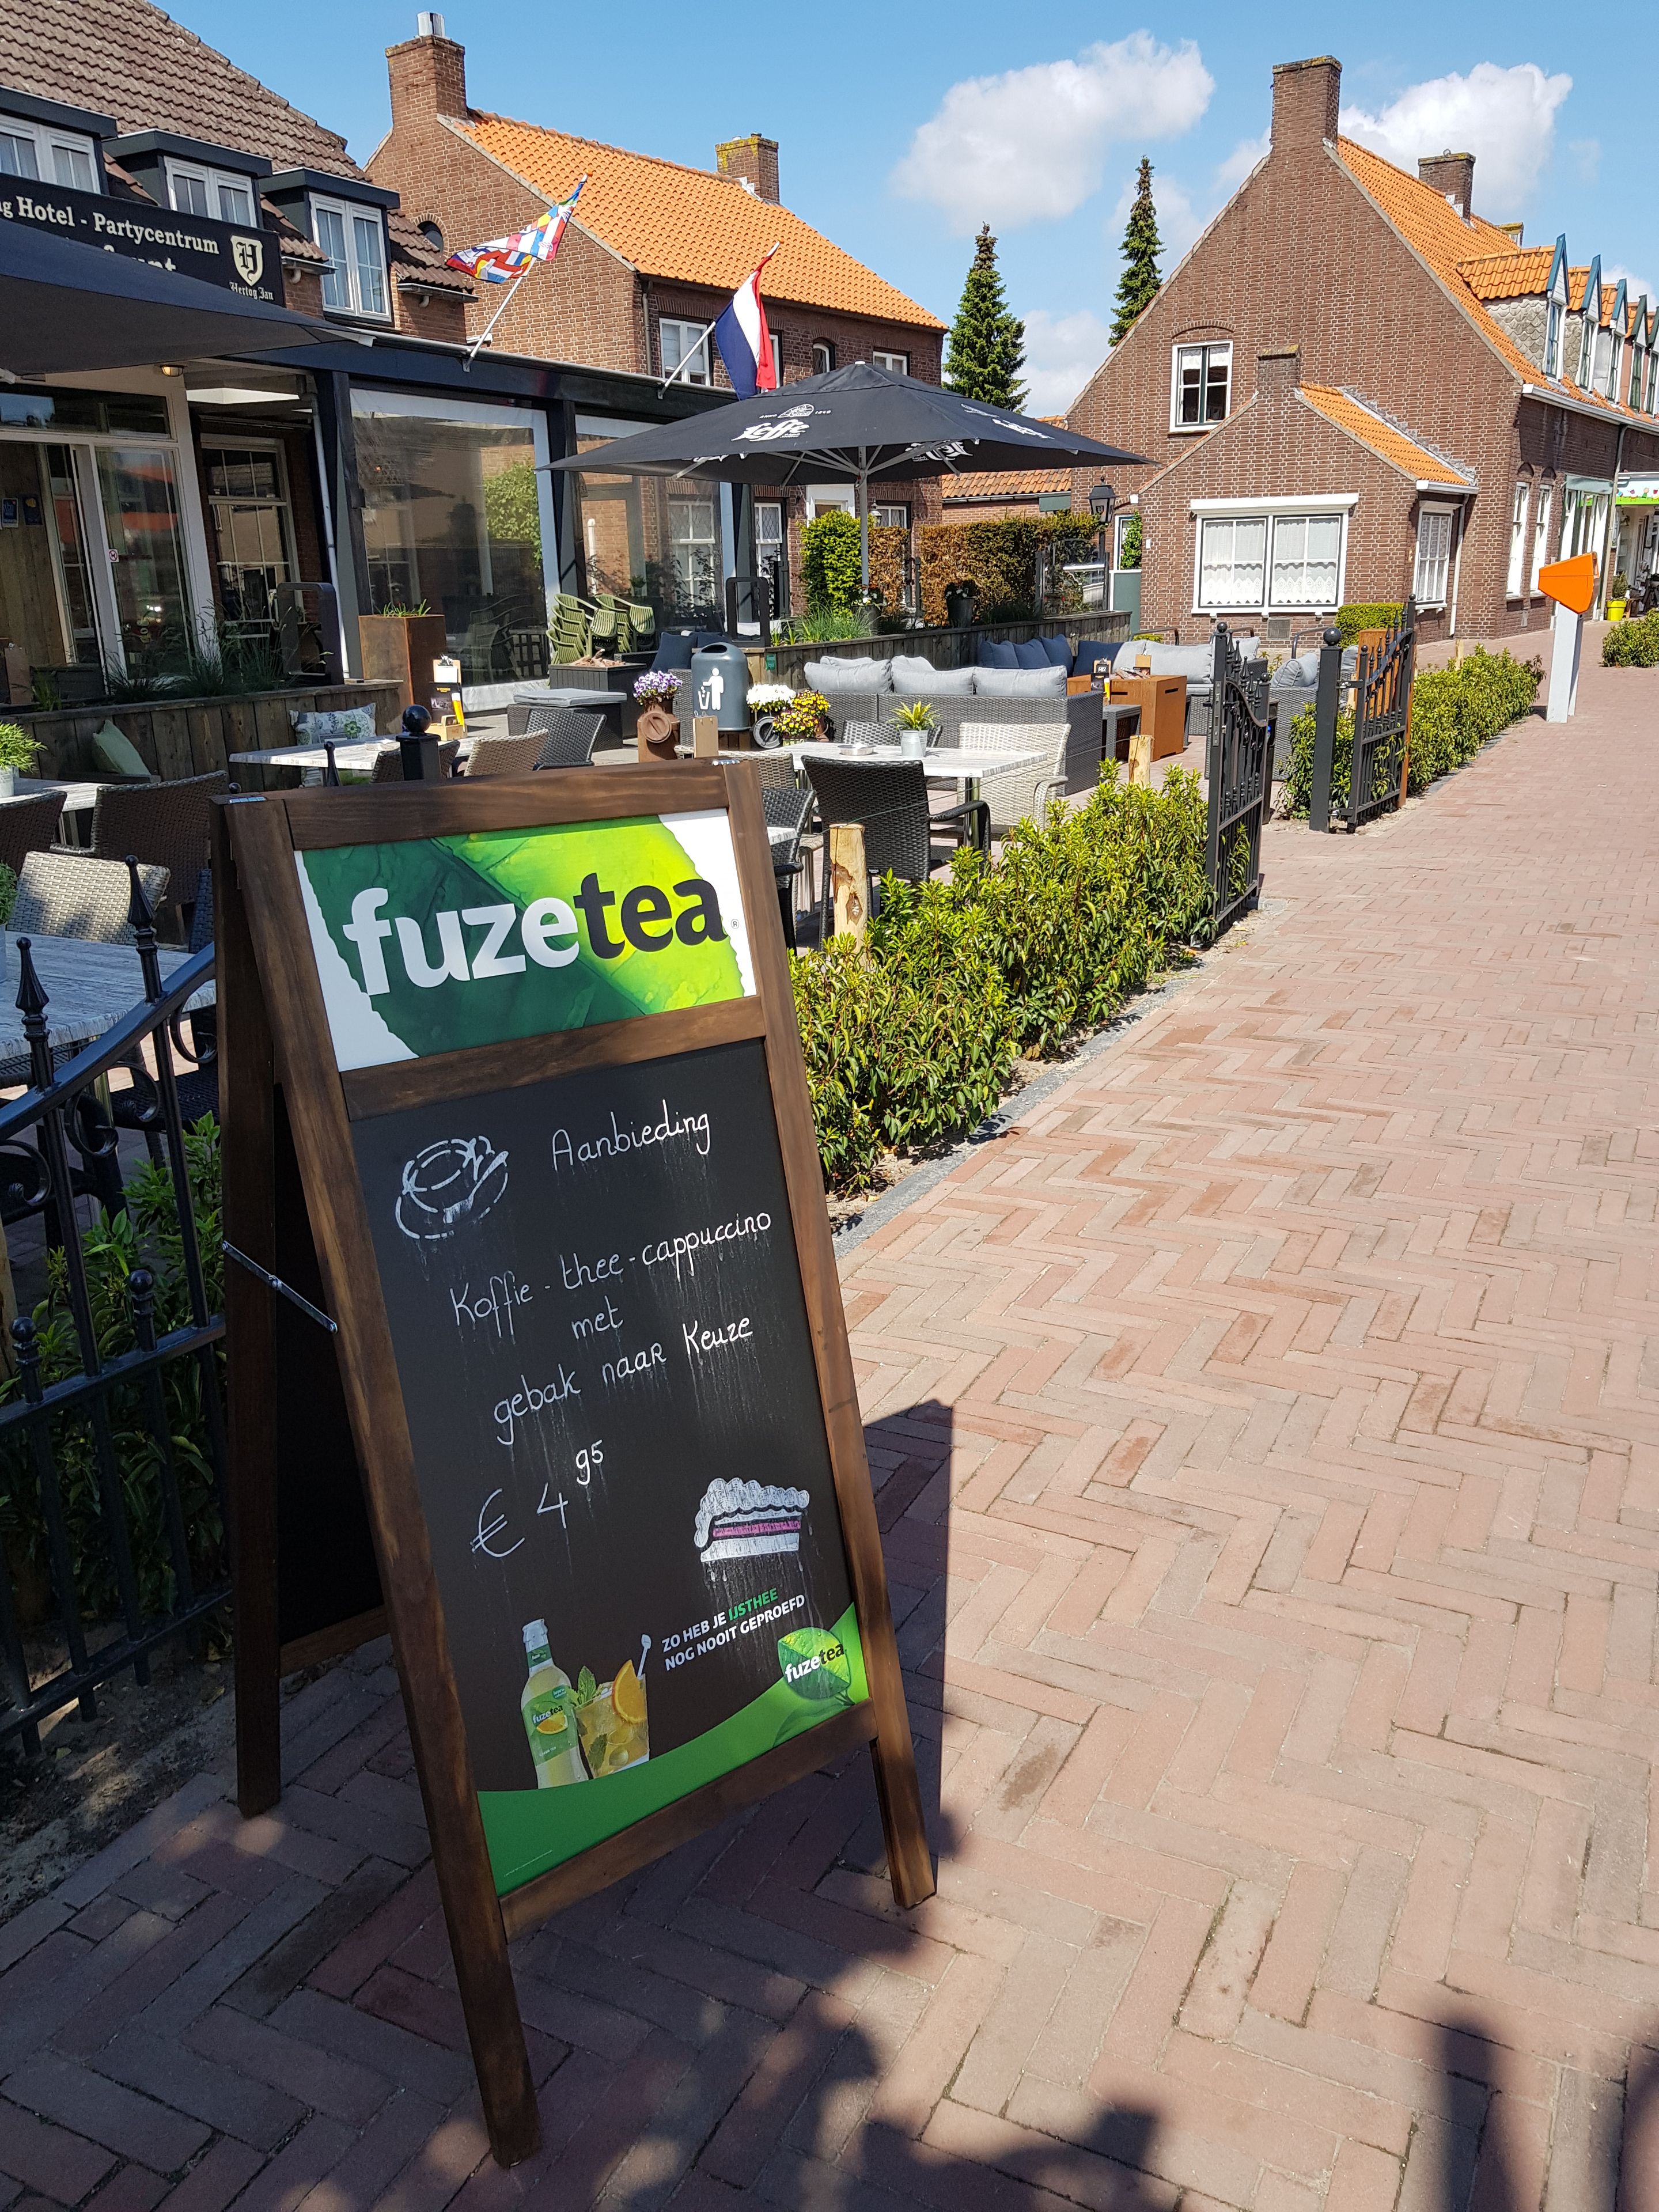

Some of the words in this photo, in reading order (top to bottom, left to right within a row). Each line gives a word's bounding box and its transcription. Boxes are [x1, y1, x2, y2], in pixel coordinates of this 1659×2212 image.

[16, 196, 75, 226] Hotel
[92, 211, 219, 254] Partycentrum
[229, 282, 257, 300] Hertog
[258, 287, 274, 301] Jan
[730, 419, 810, 442] Leffe
[343, 872, 729, 997] fuzetea
[552, 1099, 710, 1171] Aanbieding
[449, 1270, 533, 1338] Koffie
[560, 1253, 624, 1290] thee
[642, 1211, 771, 1282] cappuccino
[571, 1296, 623, 1340] met
[494, 1363, 581, 1445] gebak
[683, 1316, 753, 1355] Keuze
[470, 1487, 525, 1556] €
[536, 1482, 569, 1529] 4
[661, 1634, 681, 1653] ZO
[683, 1624, 710, 1643] HEB
[712, 1612, 727, 1629] JE
[728, 1588, 779, 1622] IJSTHEE
[664, 1648, 695, 1671] NOG
[696, 1627, 738, 1657] NOOIT
[740, 1593, 806, 1635] GEPROEFD
[785, 1643, 845, 1683] fuzetea
[532, 1705, 563, 1724] fuzetea
